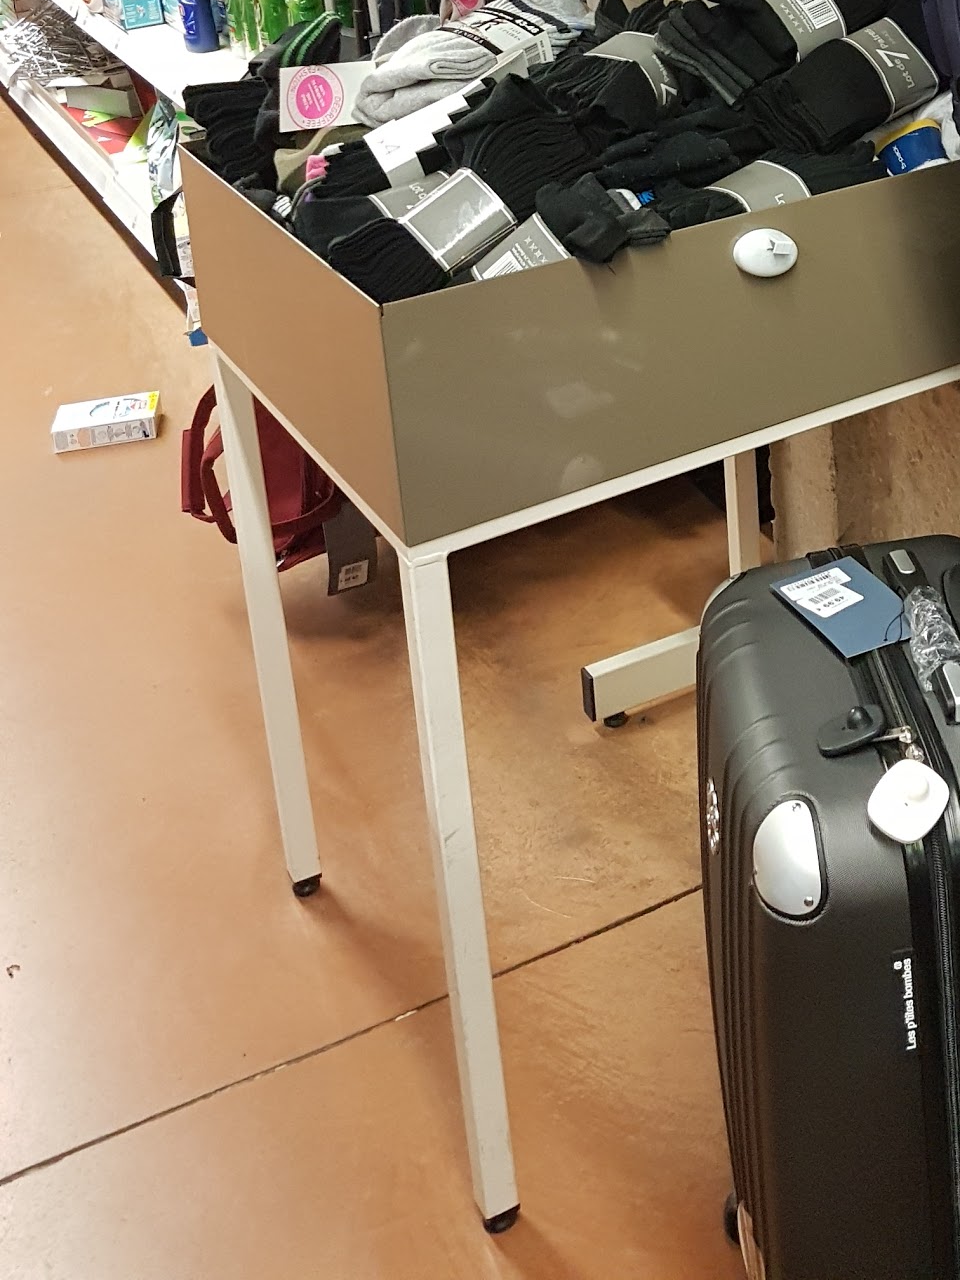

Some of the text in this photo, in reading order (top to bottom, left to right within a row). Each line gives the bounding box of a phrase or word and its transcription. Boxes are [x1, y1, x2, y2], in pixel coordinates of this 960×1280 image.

[875, 48, 910, 68] 7
[894, 58, 915, 89] Lot de
[901, 957, 913, 999] bombes
[906, 1029, 917, 1051] Les
